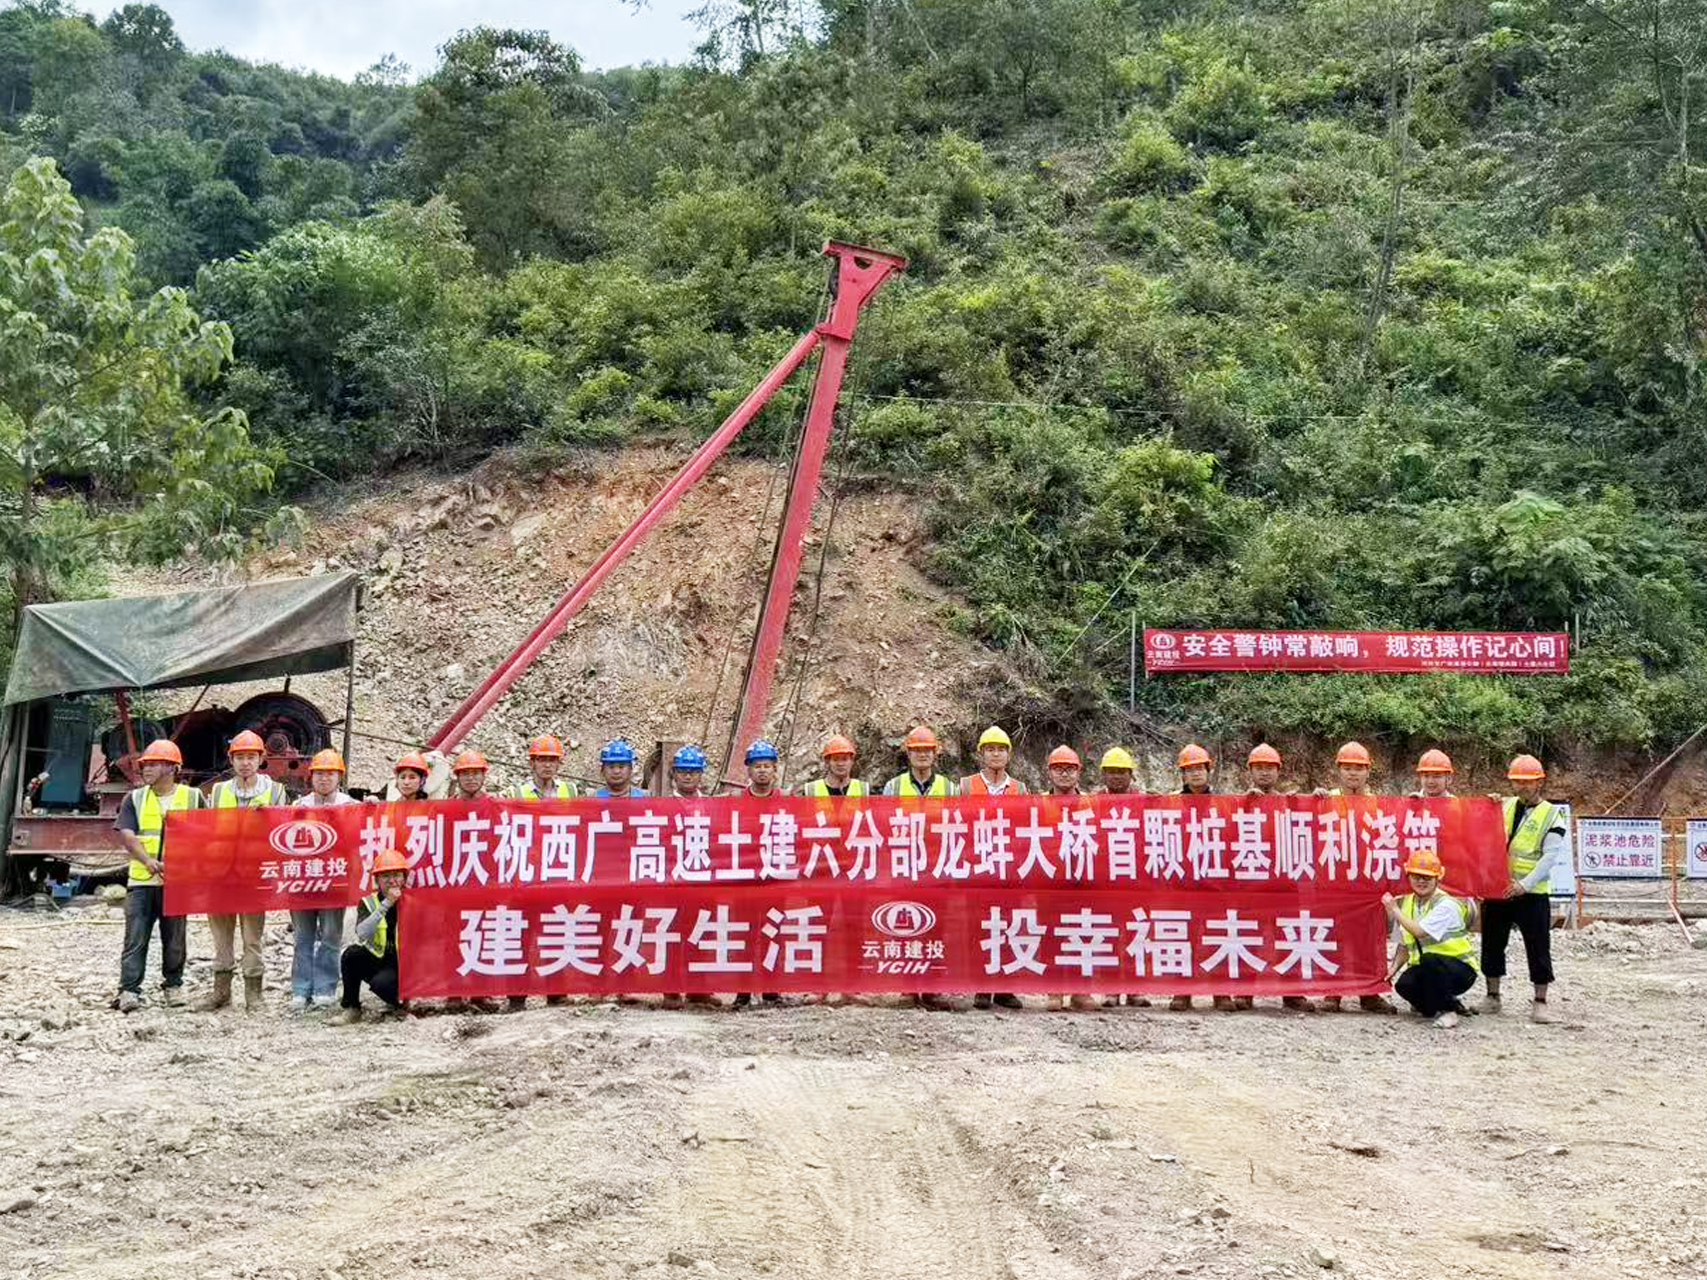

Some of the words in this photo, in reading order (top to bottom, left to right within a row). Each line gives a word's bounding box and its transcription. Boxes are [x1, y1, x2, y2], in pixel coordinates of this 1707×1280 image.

[1585, 833, 1655, 848] 泥浆池危险
[1603, 853, 1654, 868] 禁止靠近
[259, 858, 348, 879] 云南建投
[276, 880, 331, 893] YCIH
[457, 904, 828, 976] 建美好生活
[981, 906, 1340, 979] 投幸福未来
[862, 940, 945, 959] 云南建投
[877, 961, 931, 974] YCIH
